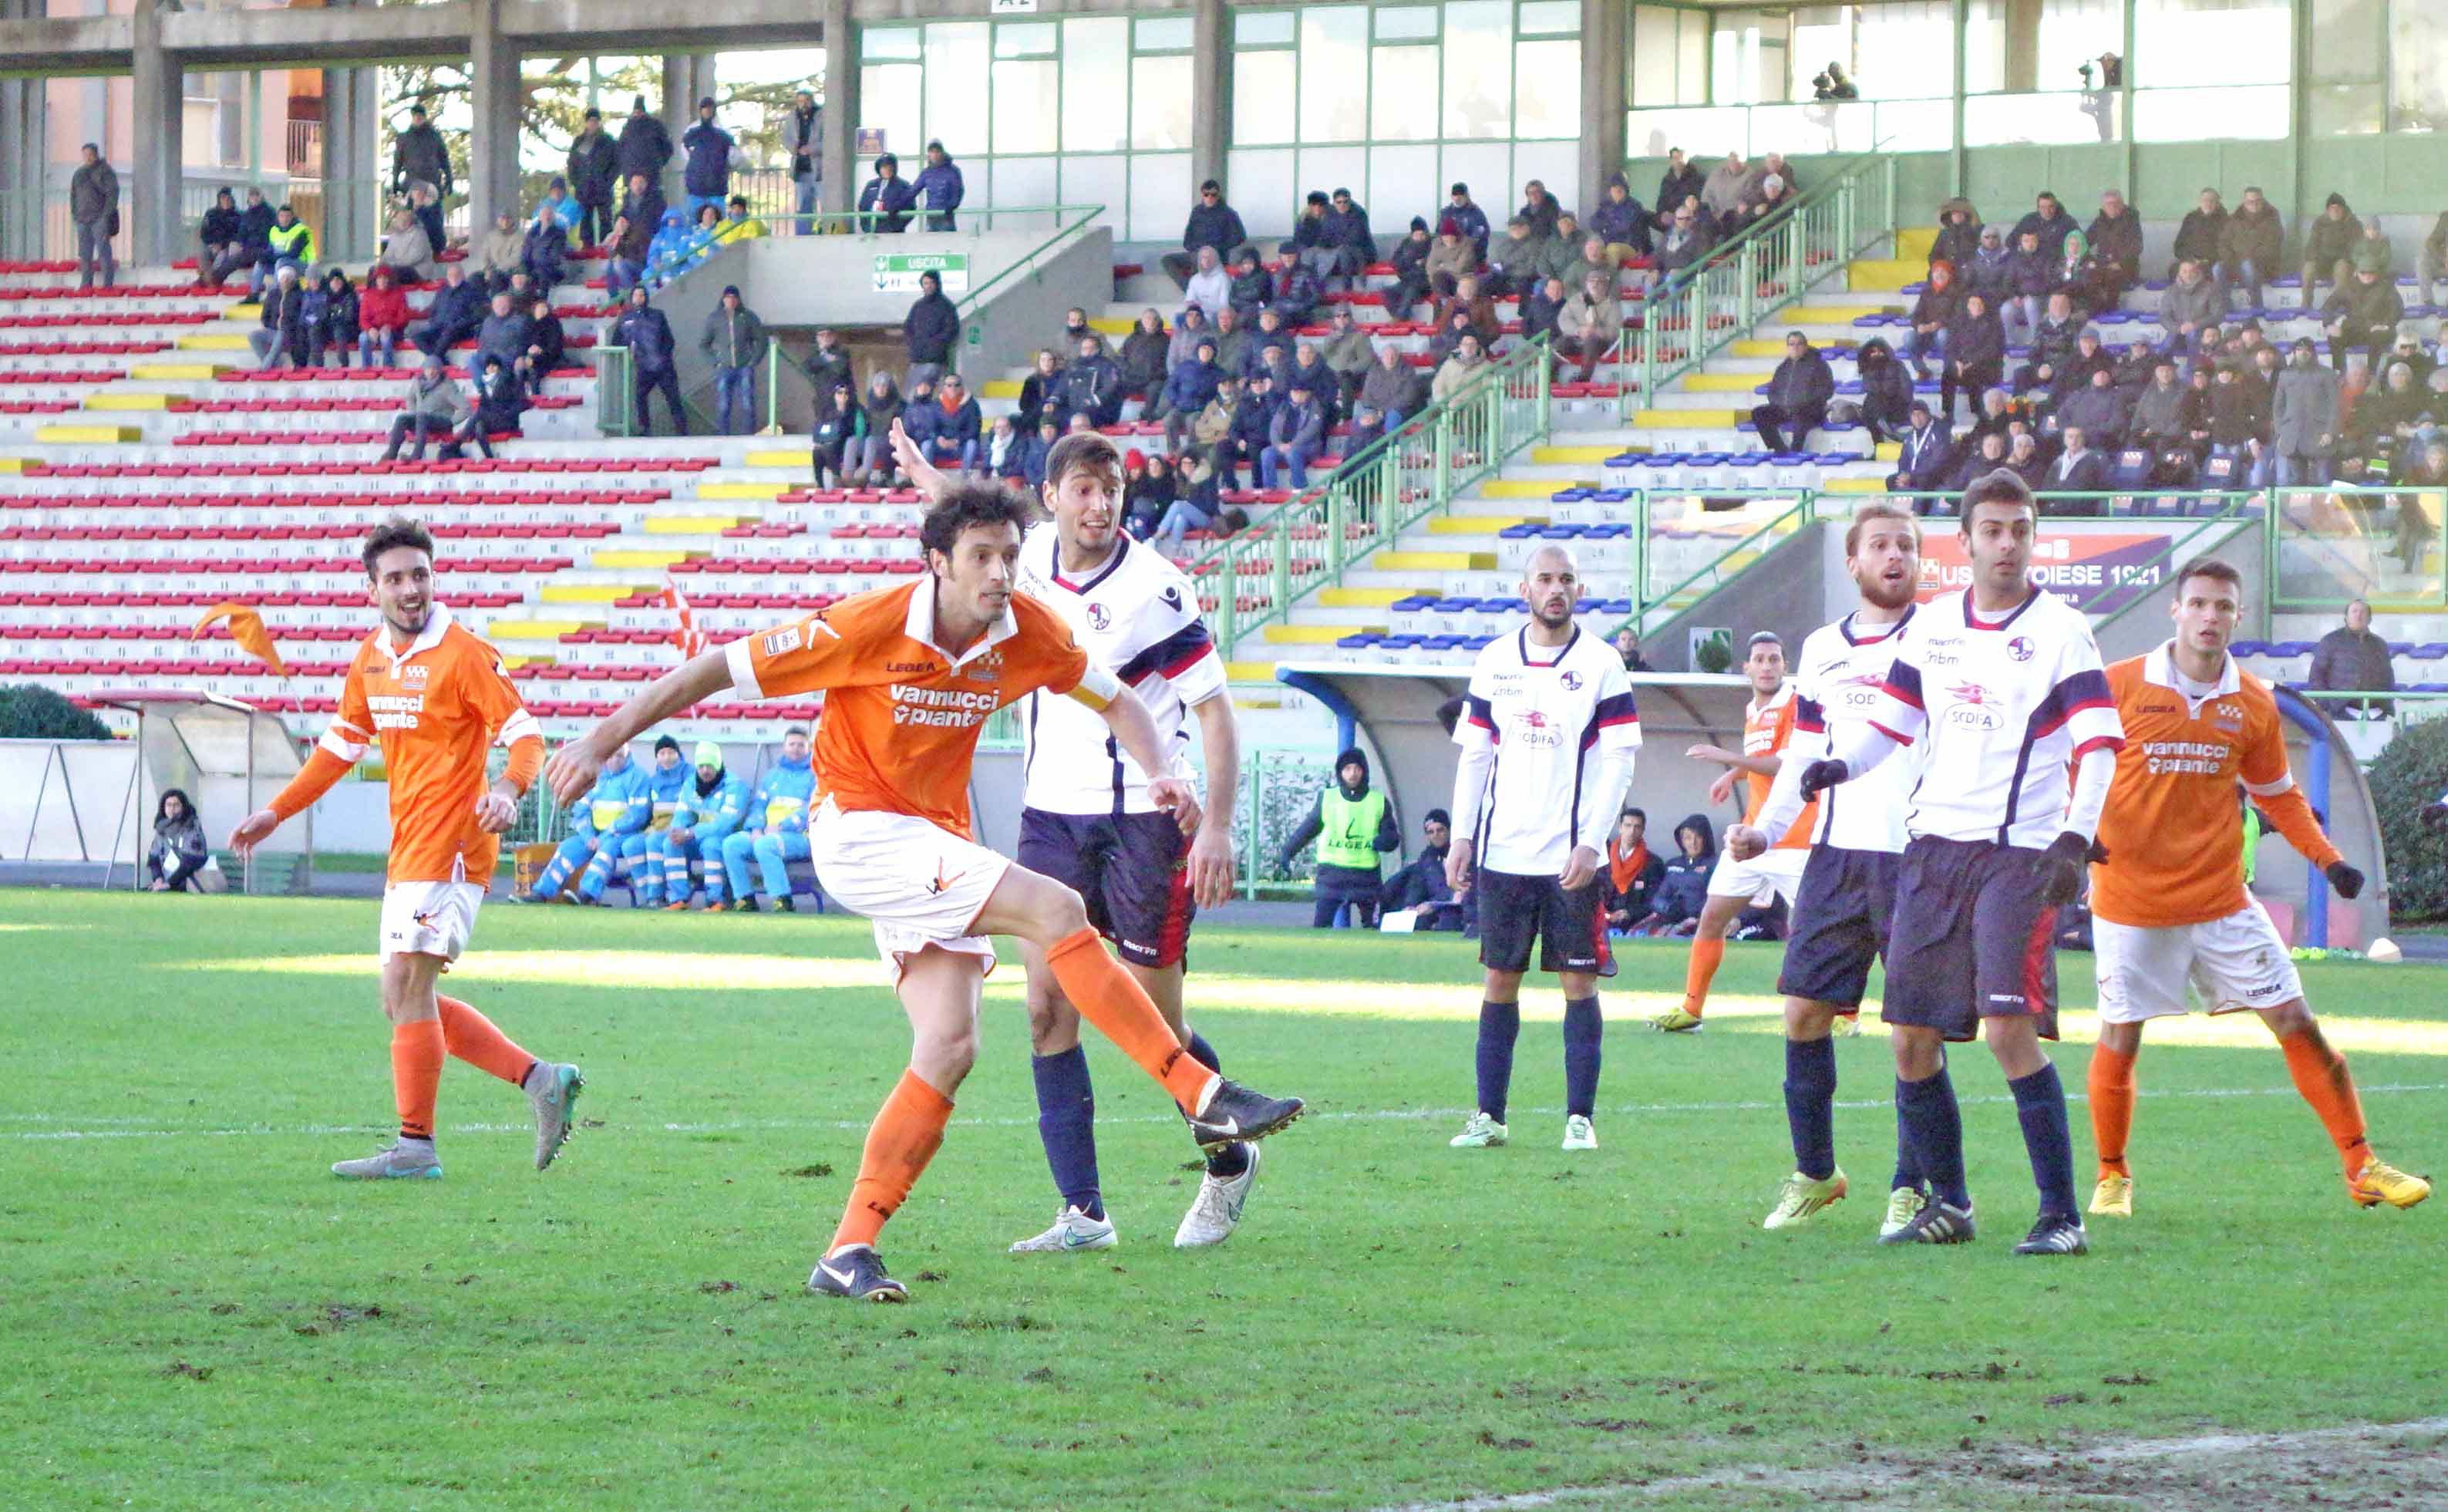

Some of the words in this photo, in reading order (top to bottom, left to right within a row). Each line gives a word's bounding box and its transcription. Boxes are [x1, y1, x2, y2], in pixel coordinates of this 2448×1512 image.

[908, 258, 948, 268] USCITA
[1941, 566, 1974, 584] US
[2025, 565, 2103, 585] OIESE
[2110, 565, 2160, 585] 1921
[887, 662, 935, 673] LEGEA
[891, 683, 999, 709] vannucci
[910, 709, 983, 727] piante
[1522, 732, 1555, 746] ODIFA
[2142, 741, 2230, 759] vannucci
[2161, 758, 2221, 775] piante
[1328, 839, 1372, 850] LEGEA
[2246, 983, 2281, 998] LEGEA
